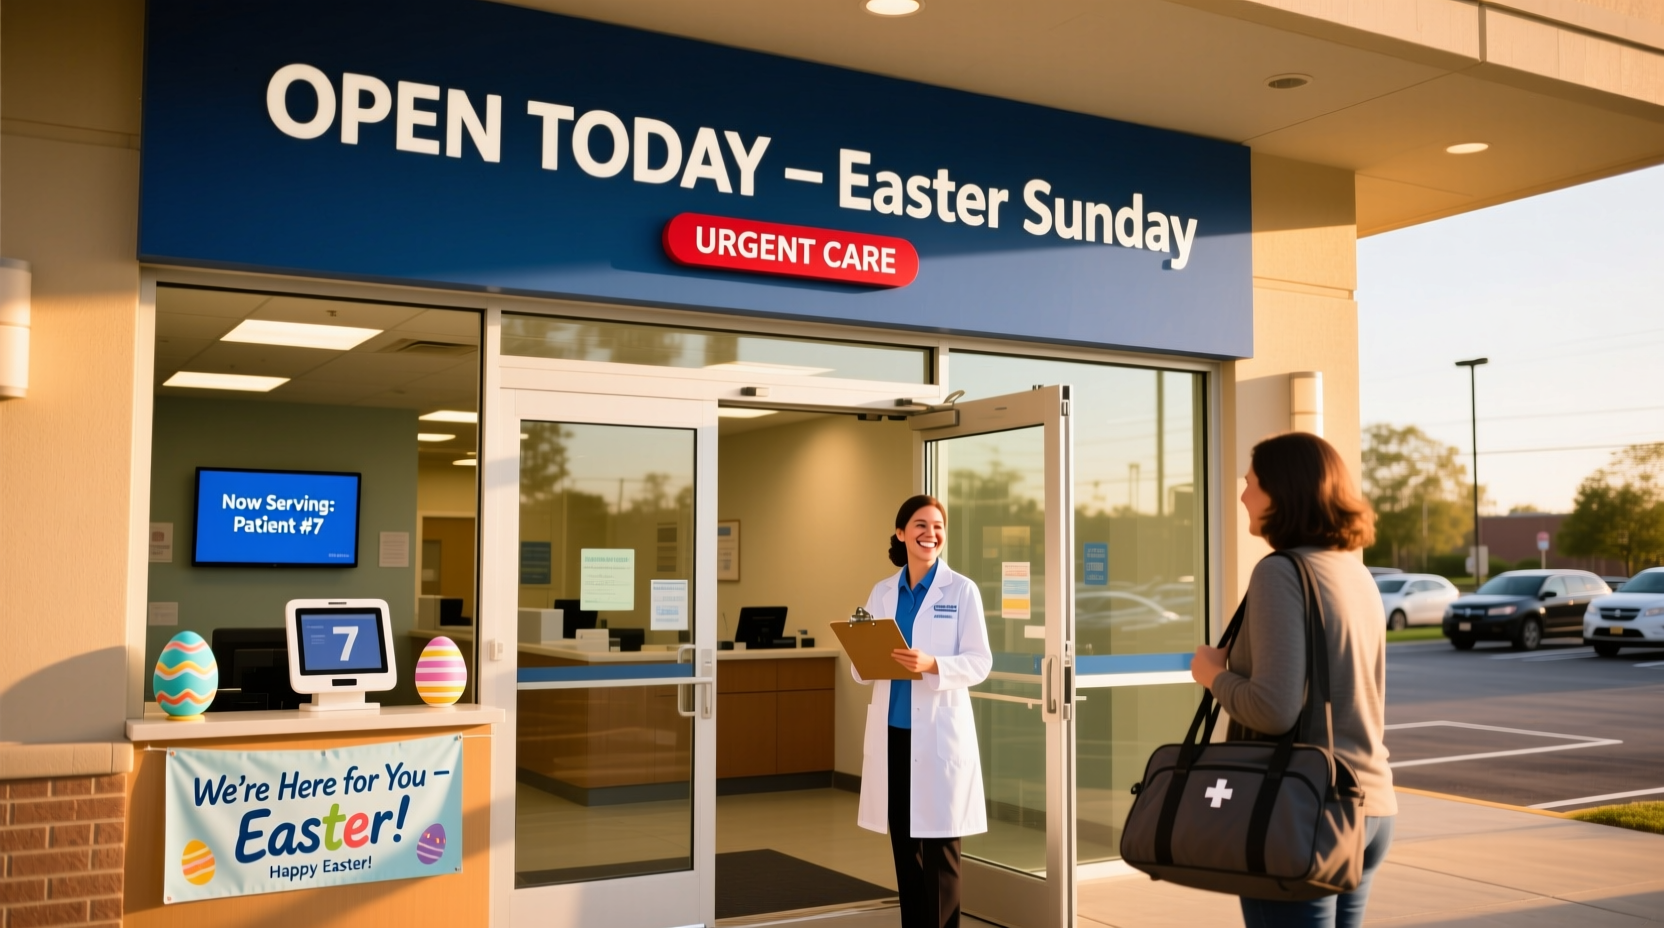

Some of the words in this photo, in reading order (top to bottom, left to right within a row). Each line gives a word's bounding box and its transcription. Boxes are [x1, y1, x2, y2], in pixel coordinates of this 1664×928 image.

[267, 63, 502, 163] OPEN
[527, 100, 771, 197] TODAY
[839, 148, 1009, 229] Easter
[1022, 179, 1198, 270] Sunday
[695, 226, 816, 265] URGENT
[822, 240, 897, 275] CARE
[222, 493, 262, 511] Now
[266, 494, 335, 516] Serving:
[233, 515, 296, 534] Patient
[299, 516, 325, 535] #7
[332, 625, 359, 662] 7
[277, 771, 337, 801] Here
[343, 765, 379, 795] for
[385, 762, 426, 791] You
[235, 794, 411, 864] Easter!
[269, 864, 318, 882] Happy
[322, 855, 372, 873] Easter!
